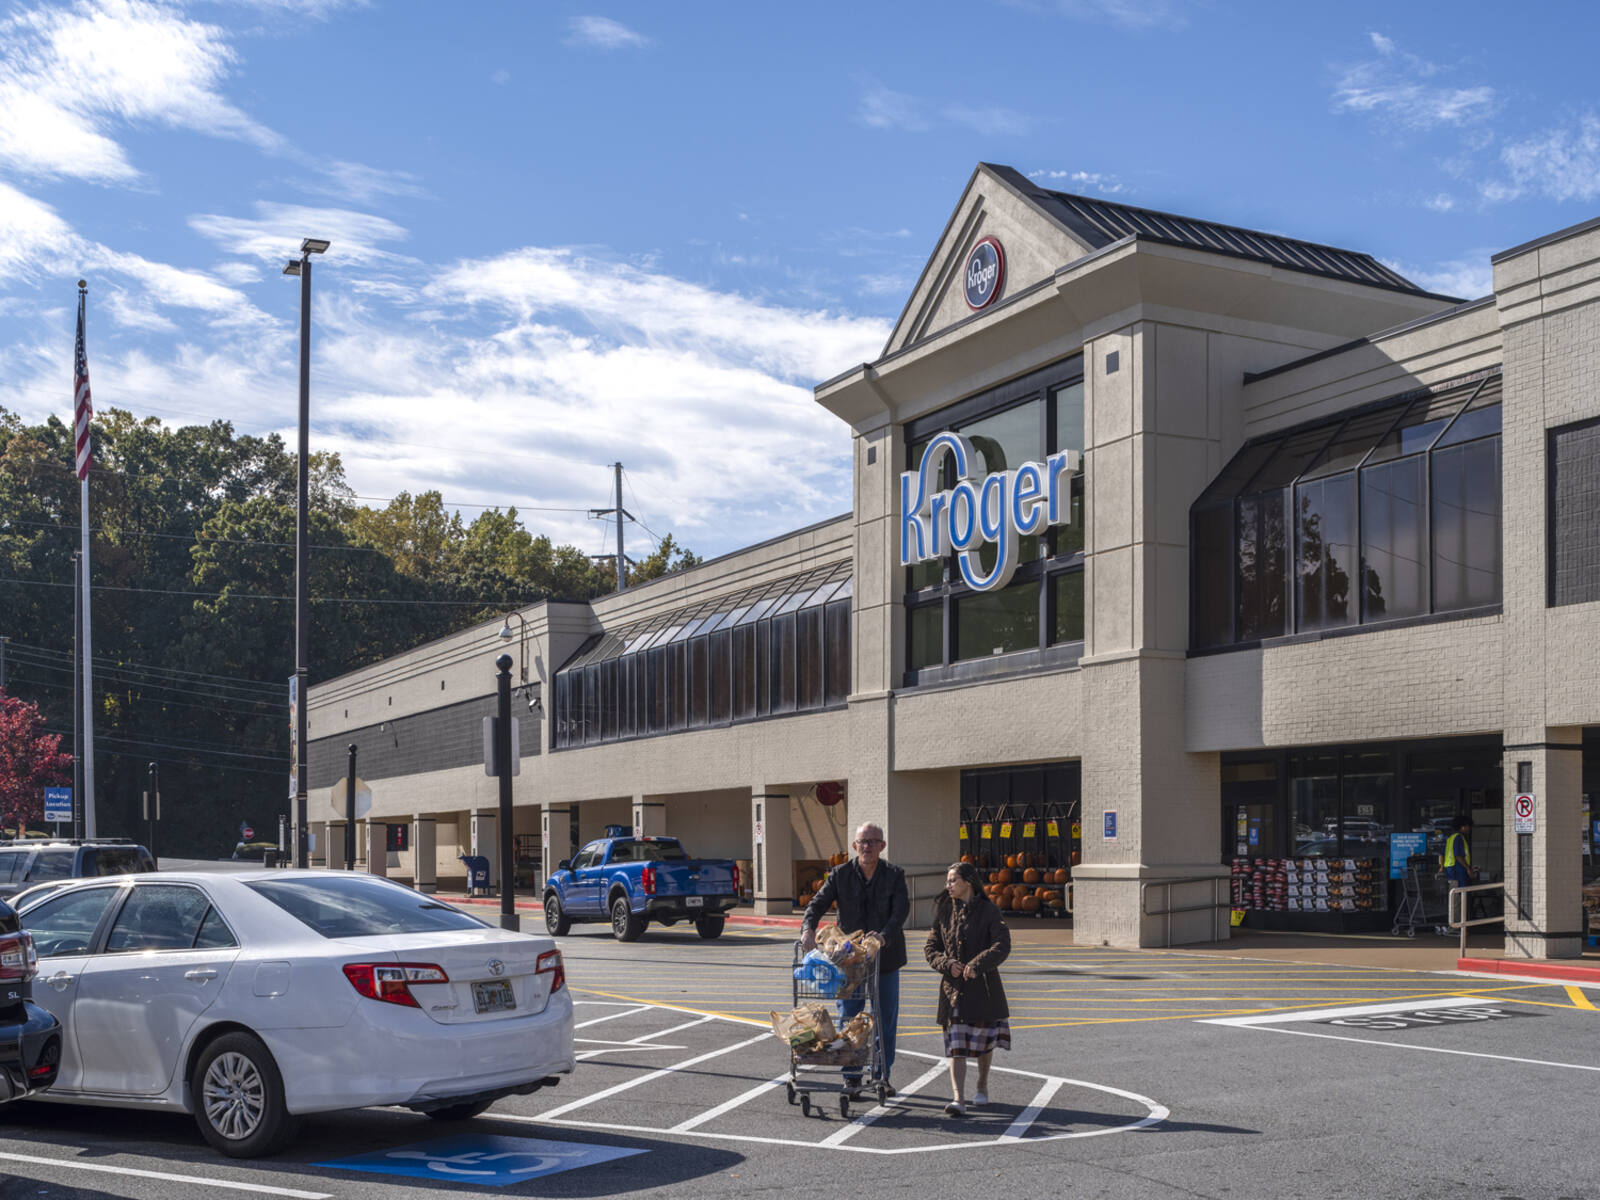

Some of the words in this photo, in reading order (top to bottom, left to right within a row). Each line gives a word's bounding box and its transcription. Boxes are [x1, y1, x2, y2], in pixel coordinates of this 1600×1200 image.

[968, 258, 996, 295] Kroger
[900, 431, 1078, 591] Kroger
[48, 792, 69, 800] Pickup
[8, 992, 20, 1000] SL
[1330, 1008, 1512, 1030] STOP
